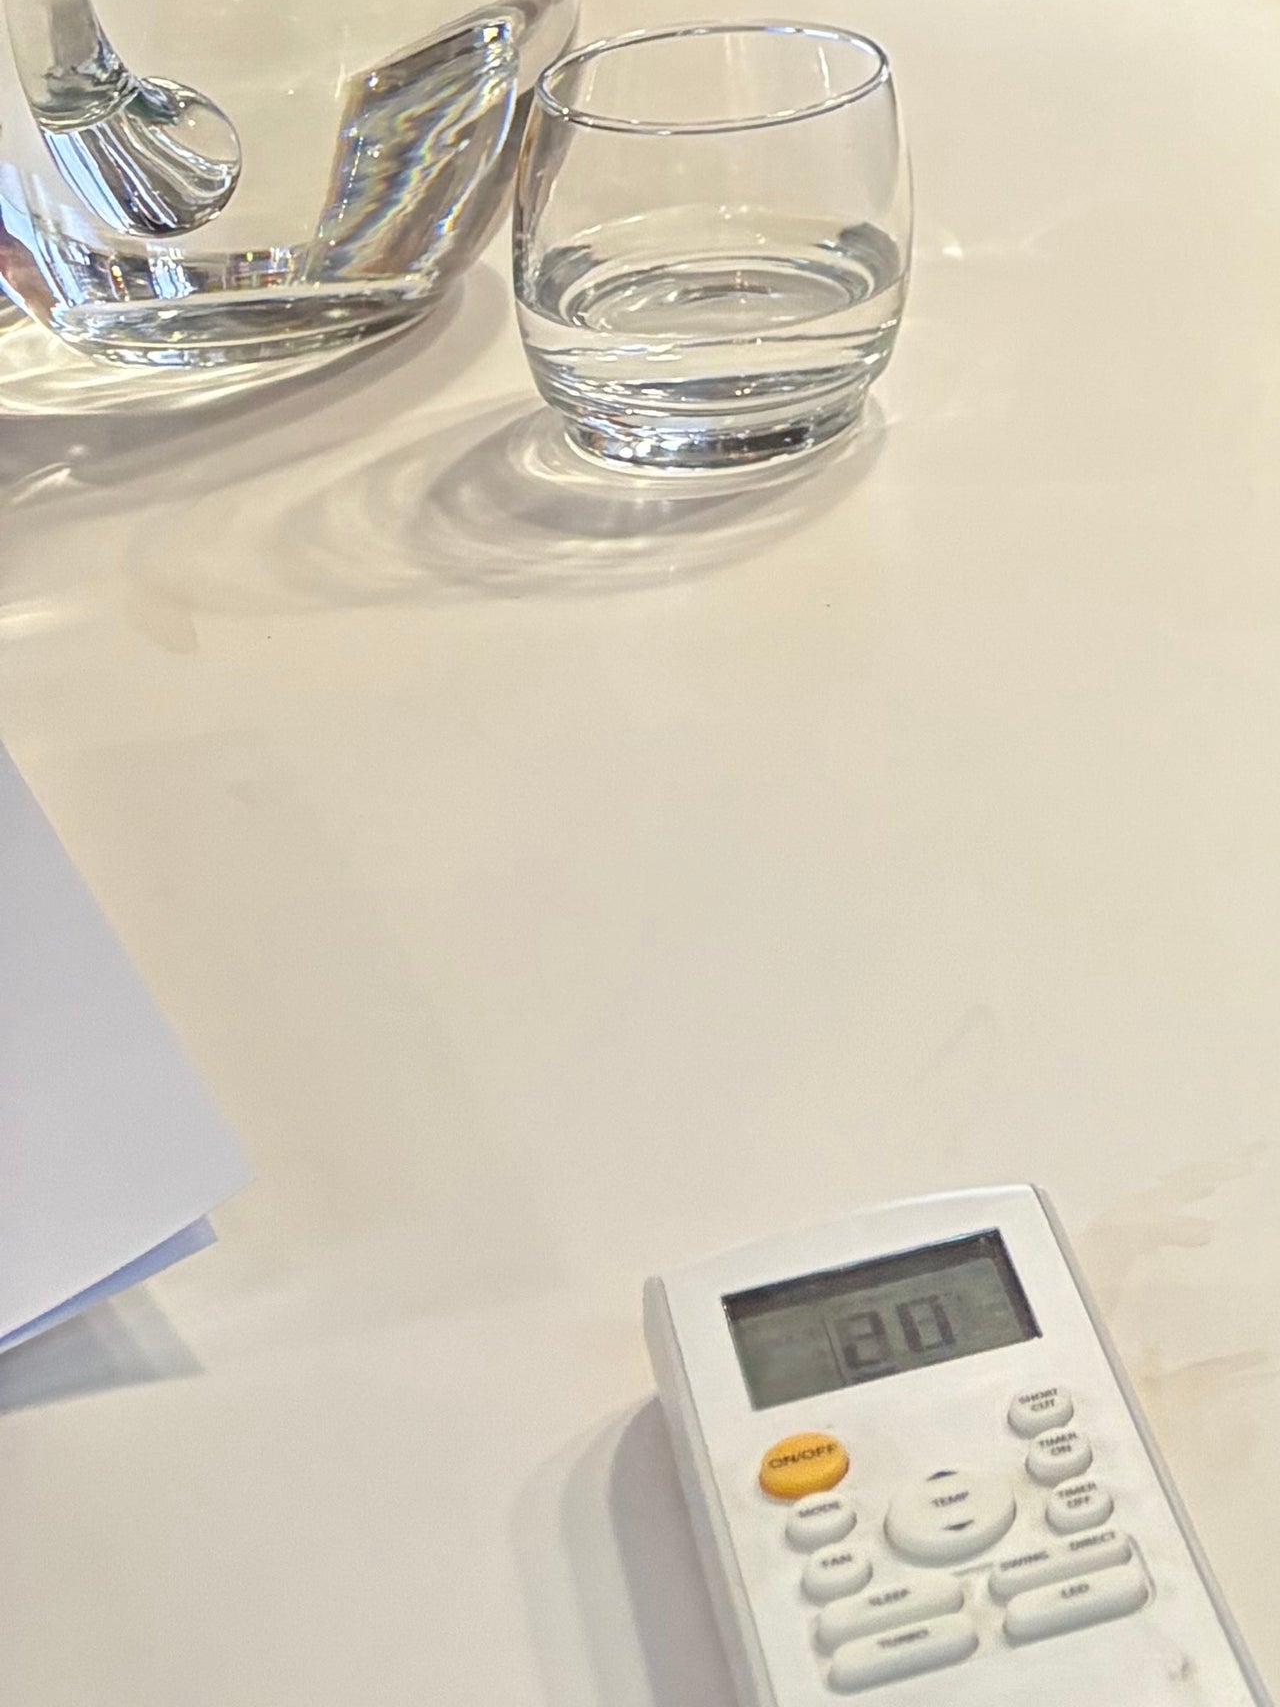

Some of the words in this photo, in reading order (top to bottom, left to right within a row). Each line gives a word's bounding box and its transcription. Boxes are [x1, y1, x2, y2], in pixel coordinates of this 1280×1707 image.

[1038, 1431, 1078, 1448] TIMER
[768, 1443, 838, 1469] ON/OFF
[931, 1490, 969, 1507] TEMP
[1057, 1482, 1098, 1499] TIMER
[798, 1501, 841, 1518] MODE
[820, 1553, 853, 1569] FAN
